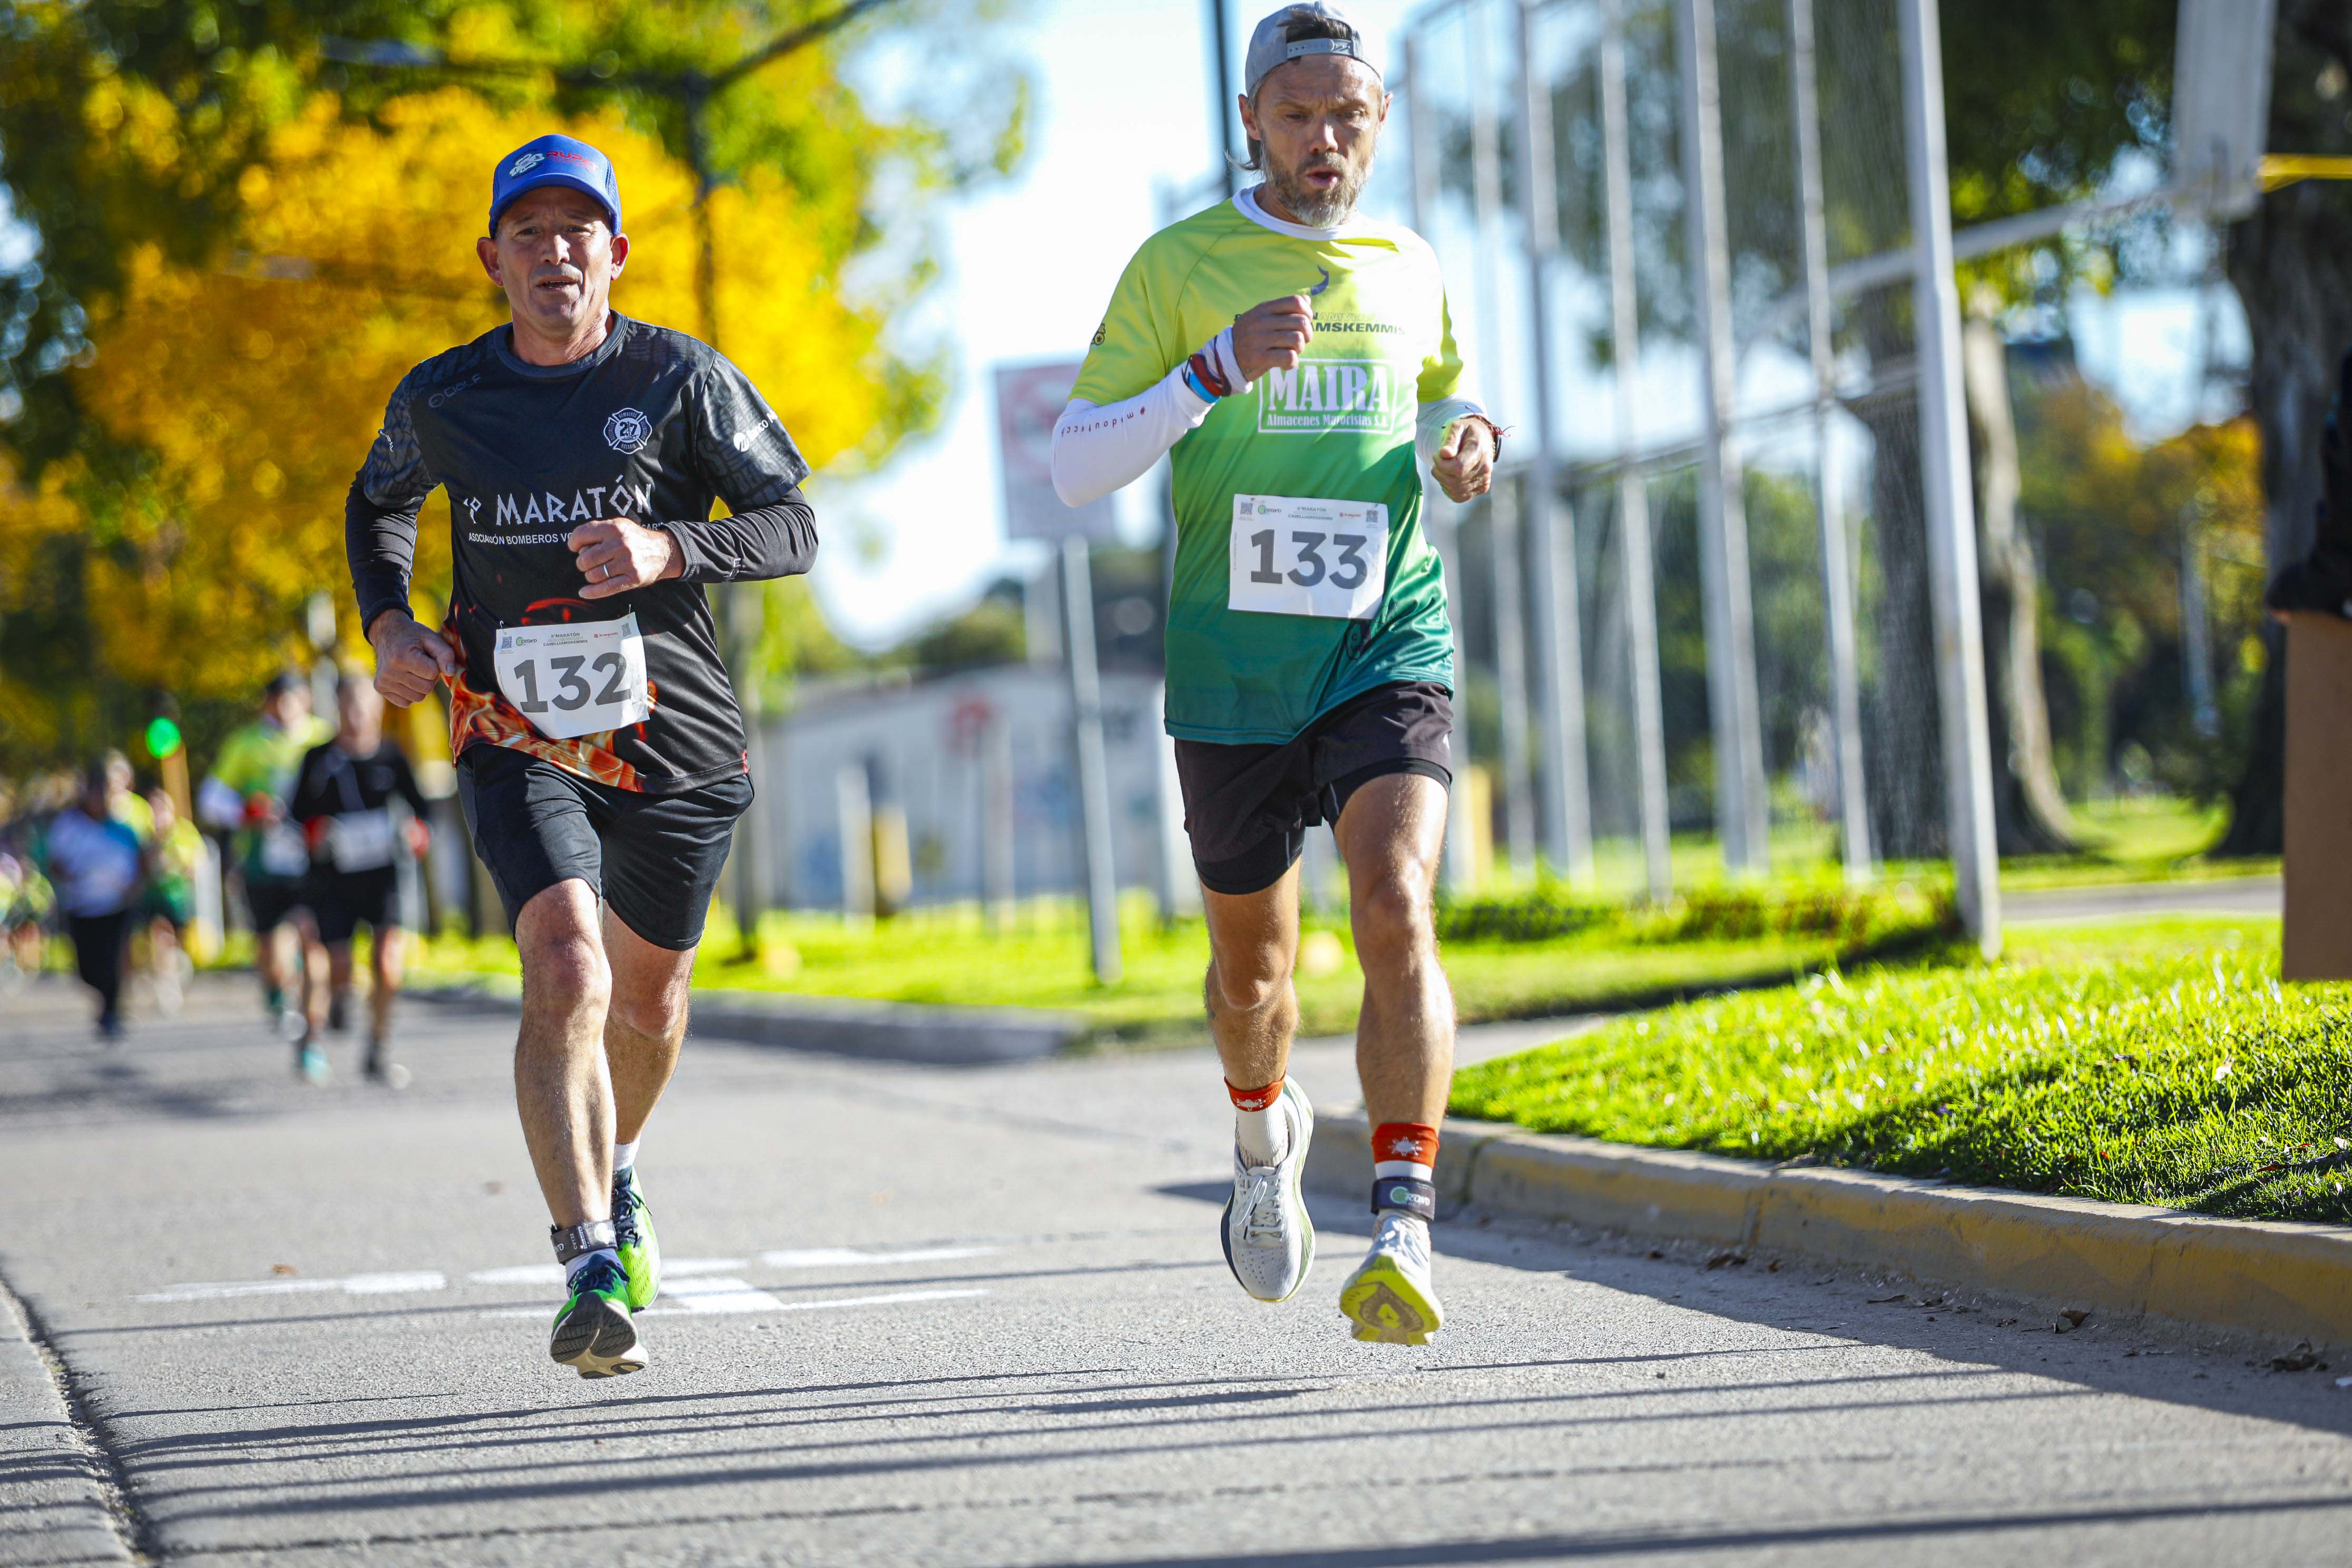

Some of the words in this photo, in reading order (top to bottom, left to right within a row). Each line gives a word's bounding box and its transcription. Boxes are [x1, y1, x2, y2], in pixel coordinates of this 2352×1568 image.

[1268, 365, 1389, 411] MAIRA
[620, 421, 638, 437] 27
[1267, 414, 1320, 426] Almacenes
[496, 474, 653, 526] MARATÓN
[506, 533, 559, 545] BOMBEROS
[1250, 528, 1368, 590] 133
[513, 652, 631, 713] 132
